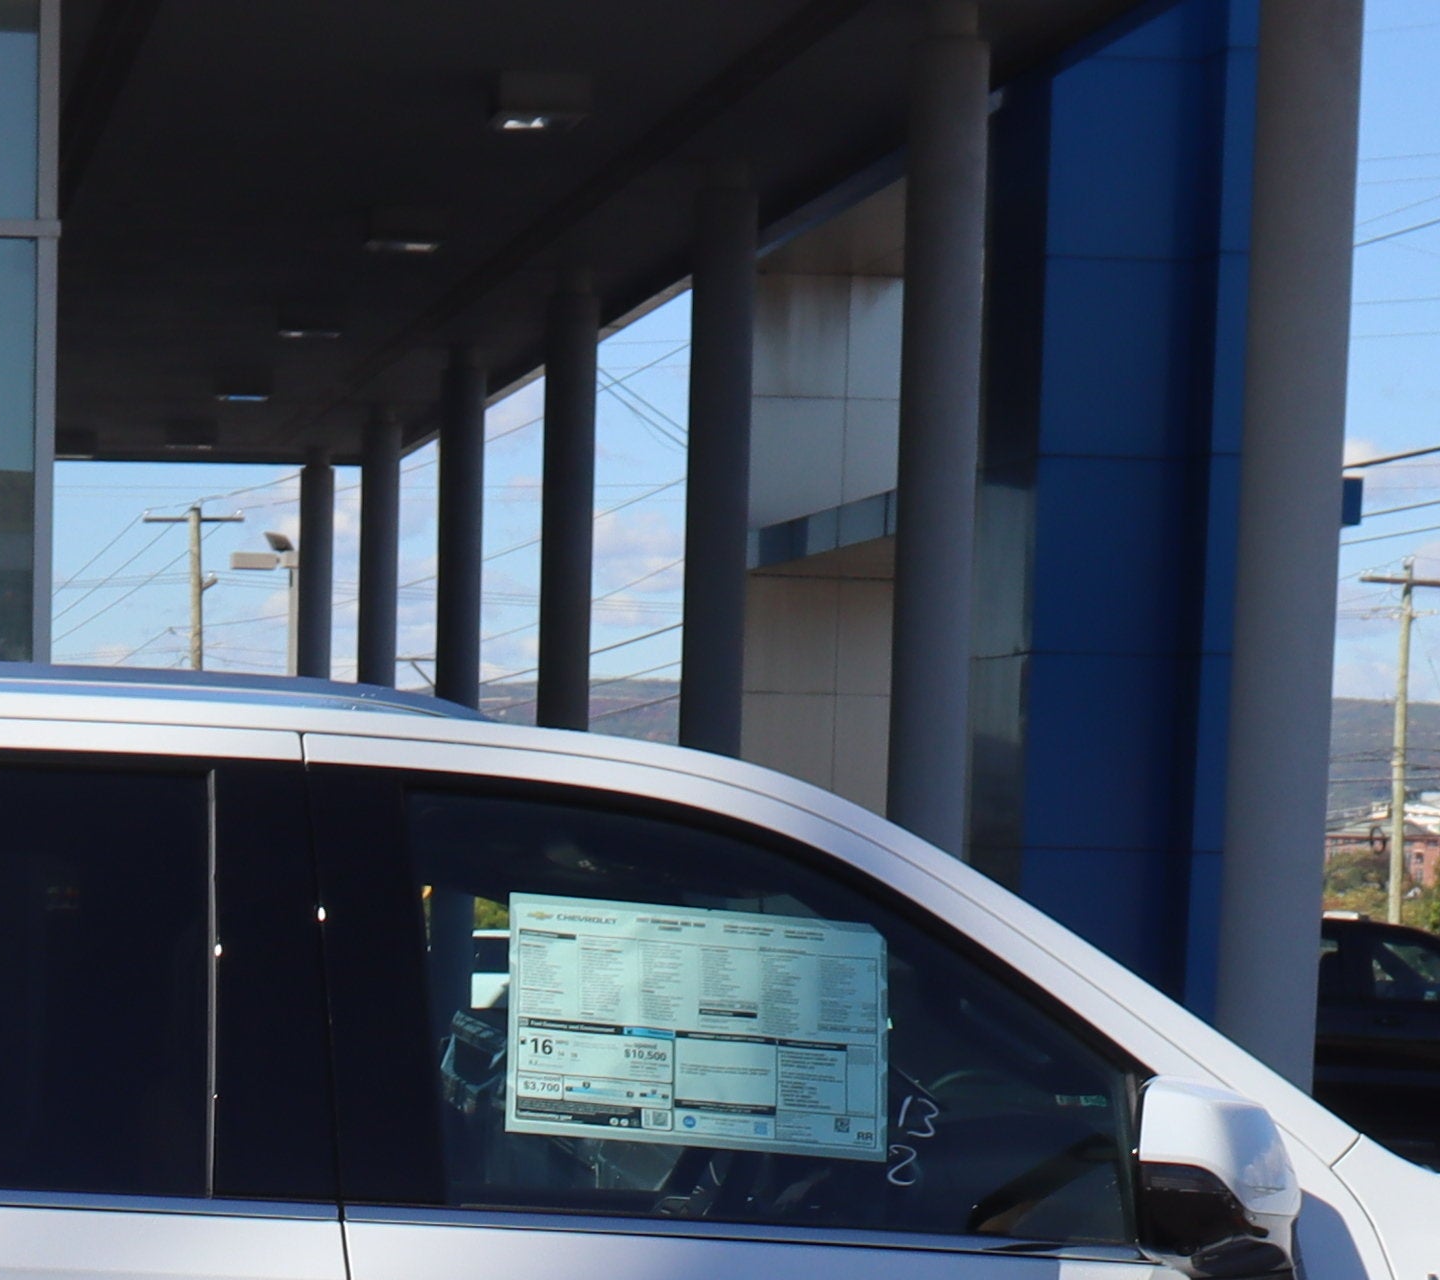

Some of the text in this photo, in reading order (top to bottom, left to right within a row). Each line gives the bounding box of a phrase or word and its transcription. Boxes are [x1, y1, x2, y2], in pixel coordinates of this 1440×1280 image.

[556, 913, 617, 926] CHEVROLET
[530, 1037, 554, 1055] 16
[624, 1048, 667, 1062] $10,500
[523, 1080, 560, 1092] $3,700
